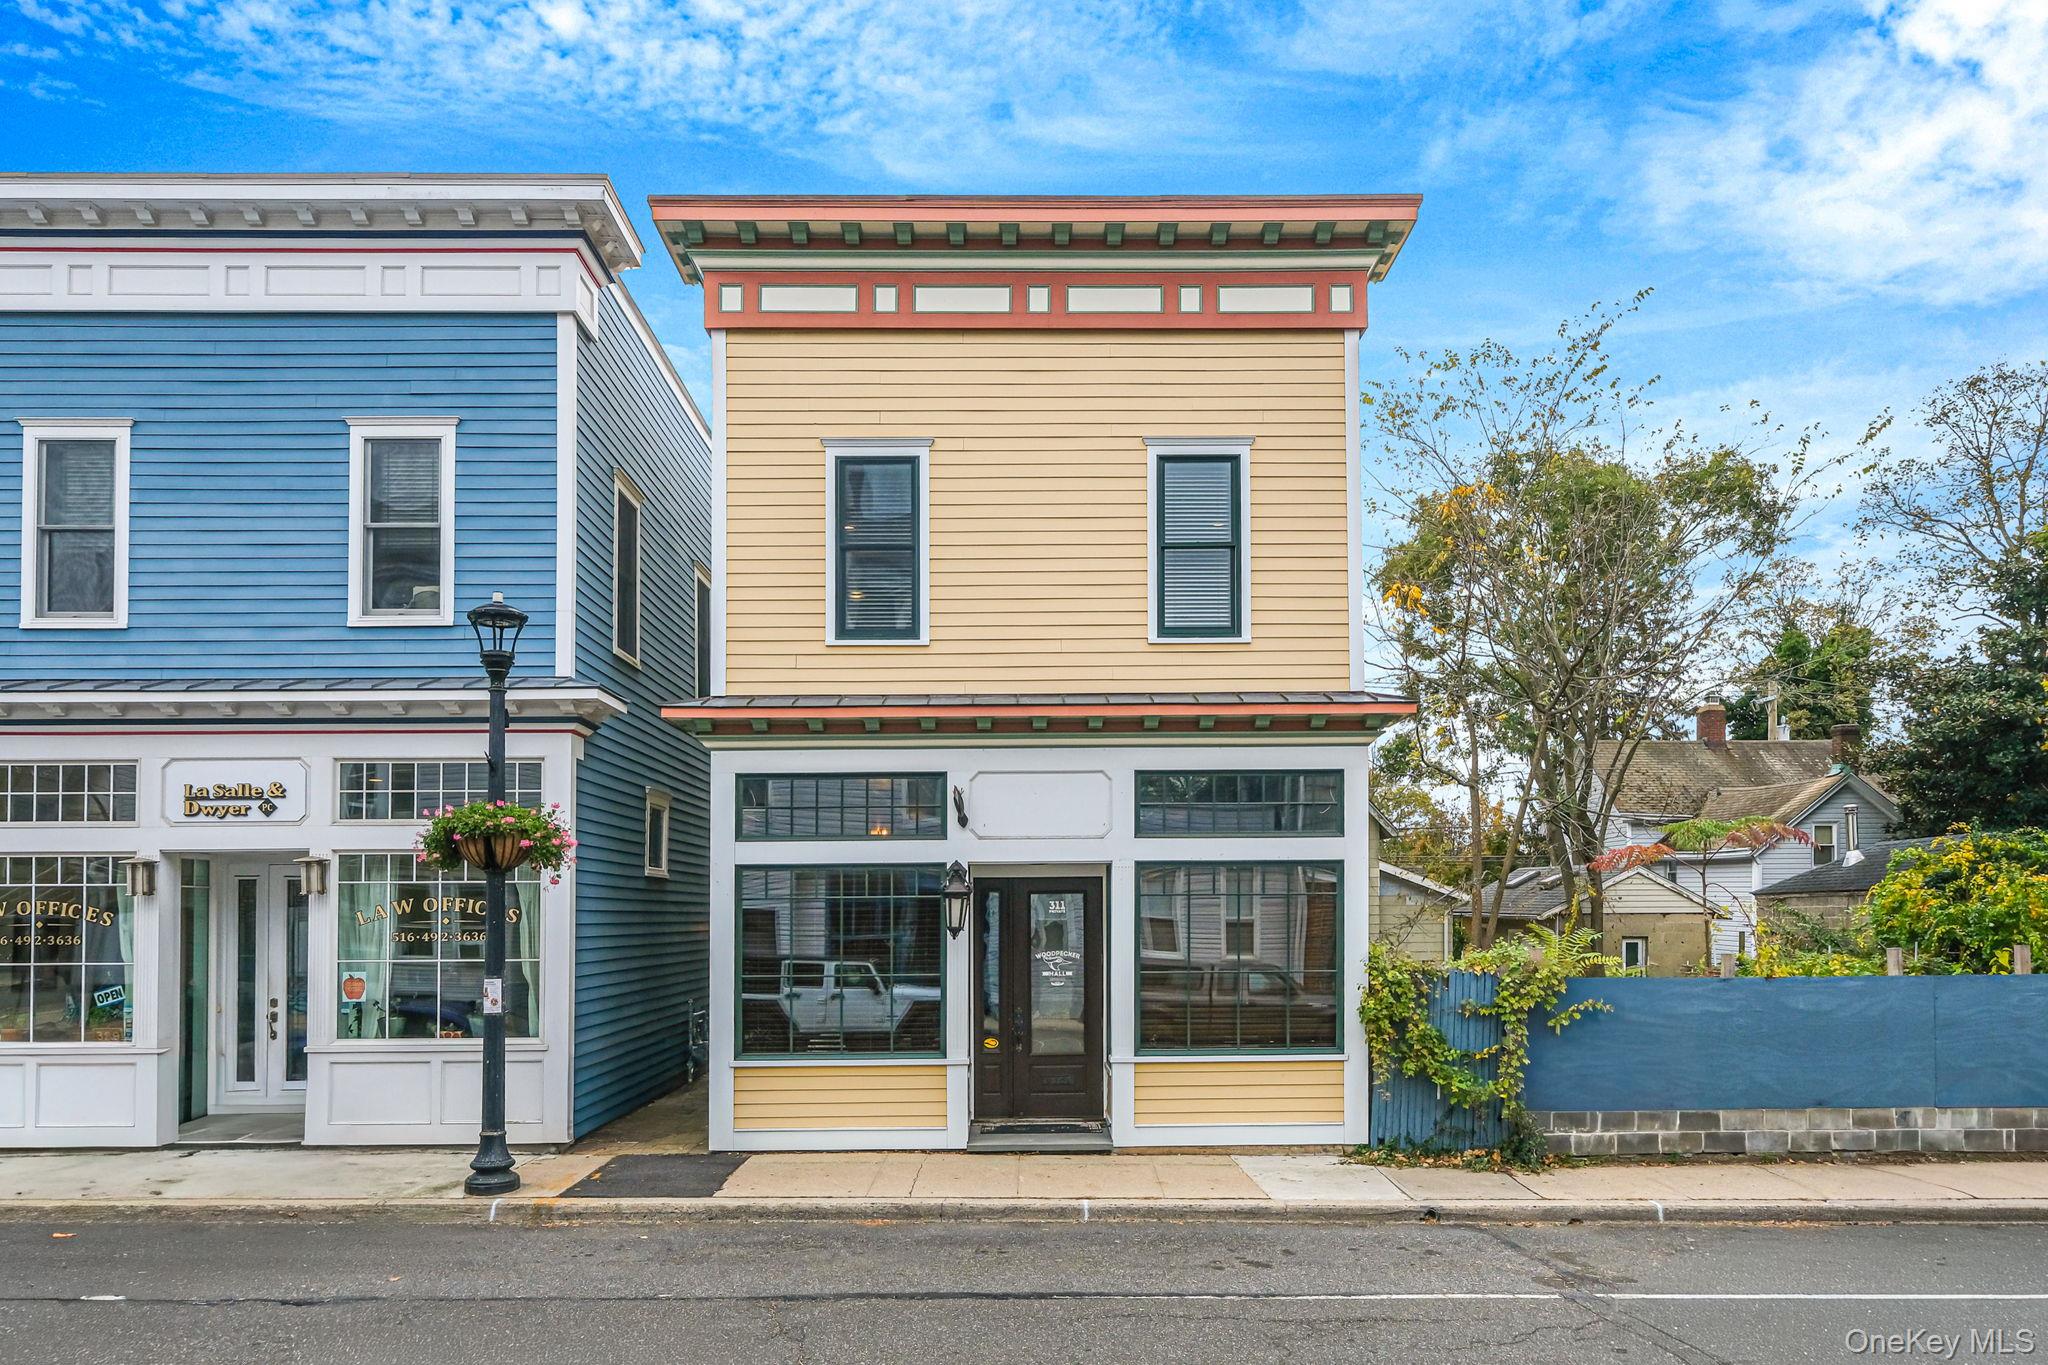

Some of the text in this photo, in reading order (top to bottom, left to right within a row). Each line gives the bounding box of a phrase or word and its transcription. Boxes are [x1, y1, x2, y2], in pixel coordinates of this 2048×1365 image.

[183, 781, 286, 799] La Salle &
[183, 800, 273, 819] Dwyer PC
[16, 900, 114, 927] OFFICES
[355, 897, 521, 926] LAW OFFICS
[1049, 900, 1065, 910] 311
[1035, 950, 1080, 960] WOODPECKER
[97, 988, 123, 1004] OPEN
